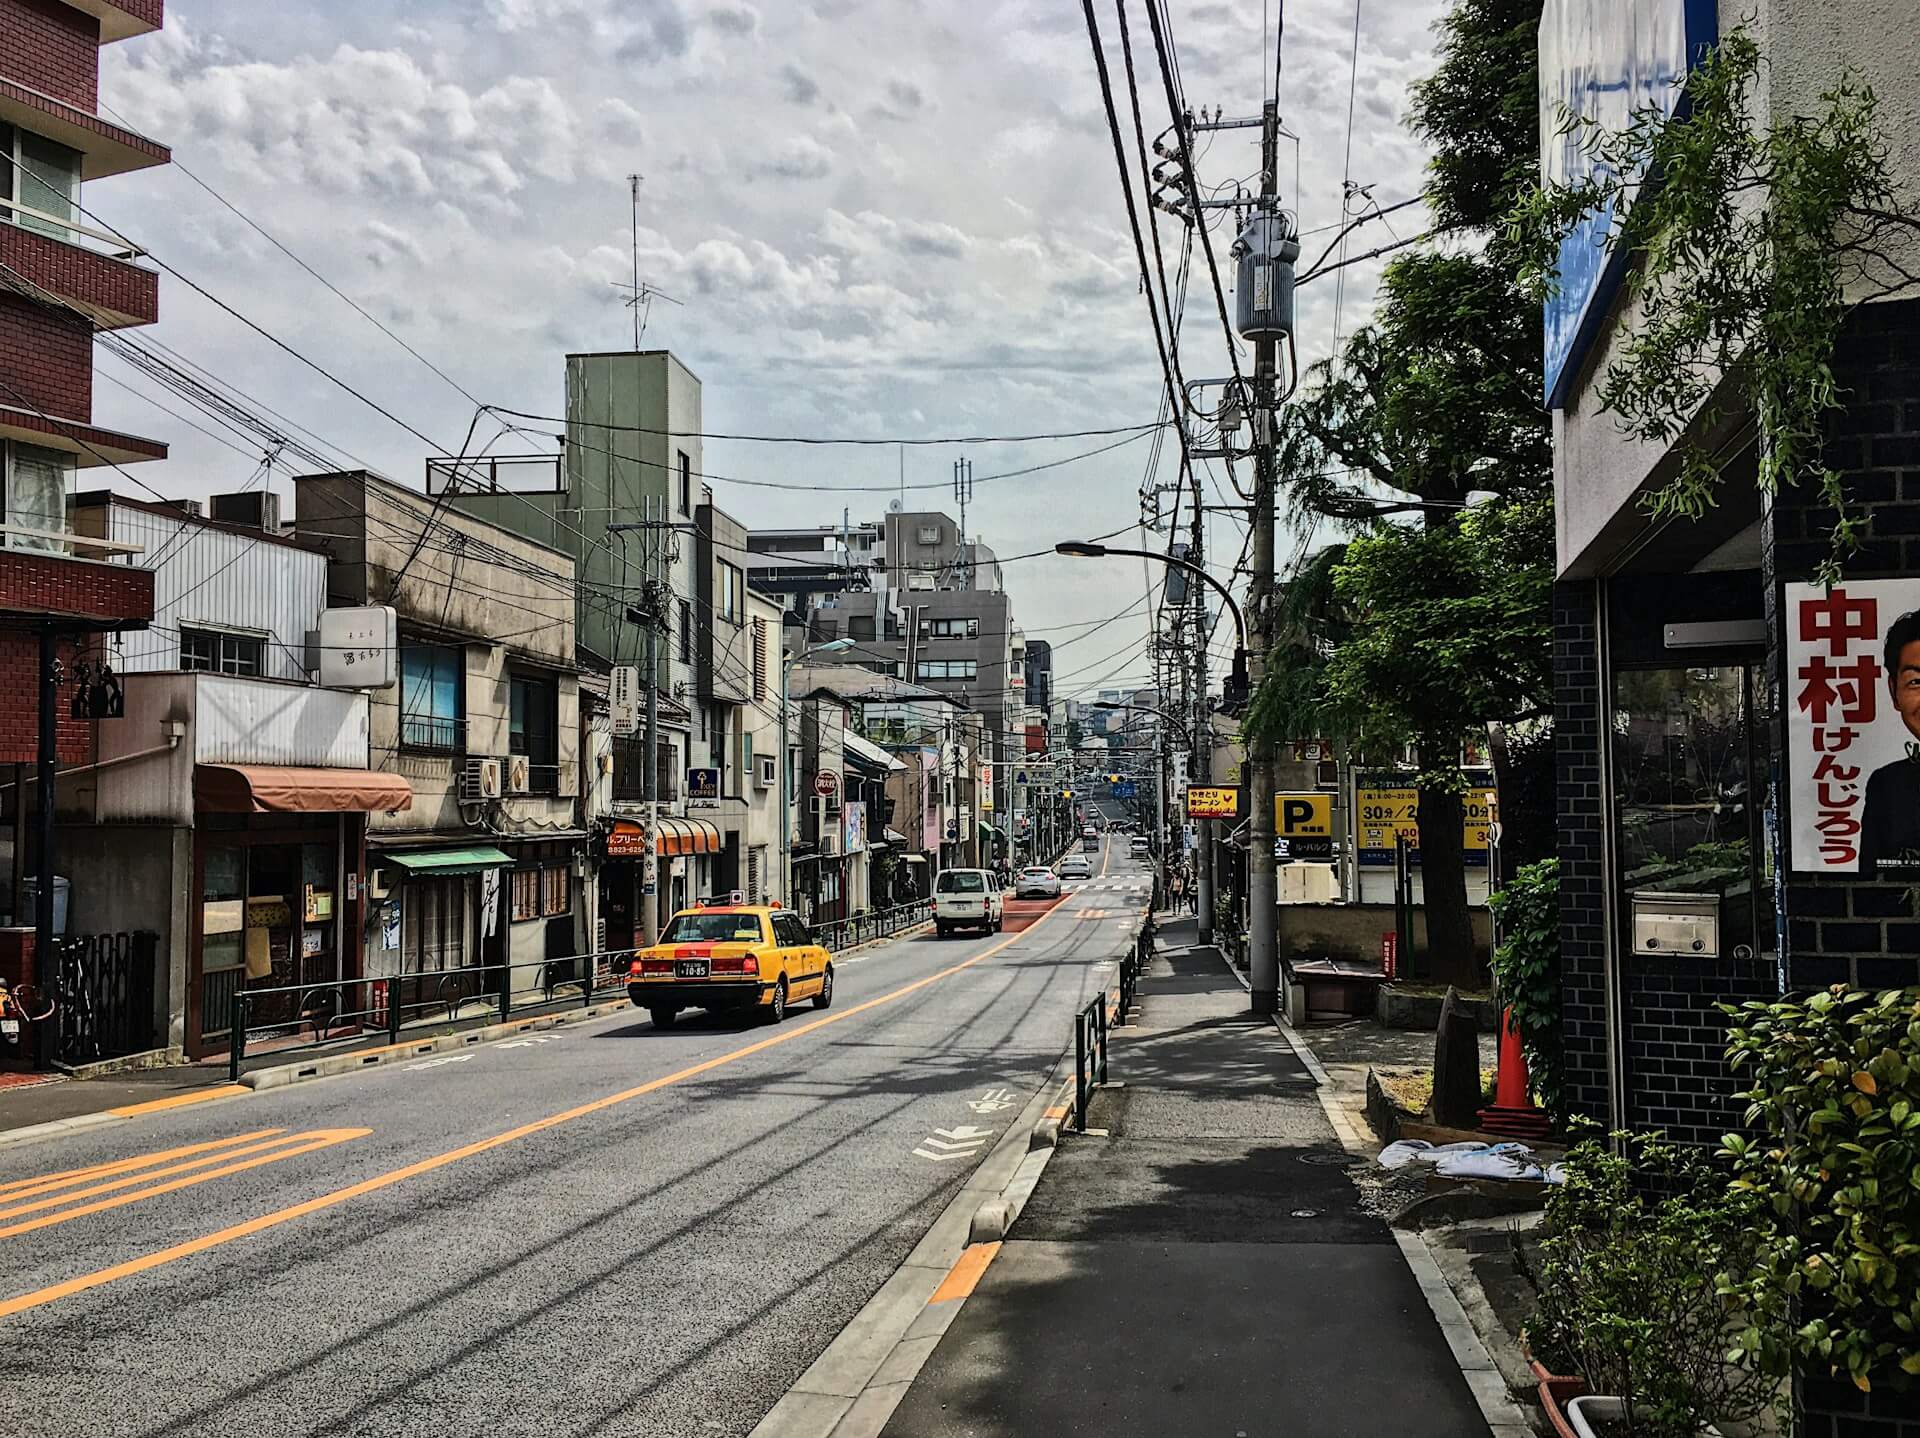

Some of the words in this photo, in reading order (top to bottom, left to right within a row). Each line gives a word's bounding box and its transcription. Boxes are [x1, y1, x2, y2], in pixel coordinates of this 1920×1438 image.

[1796, 588, 1882, 865] 中村けんじろう
[1284, 800, 1314, 833] P
